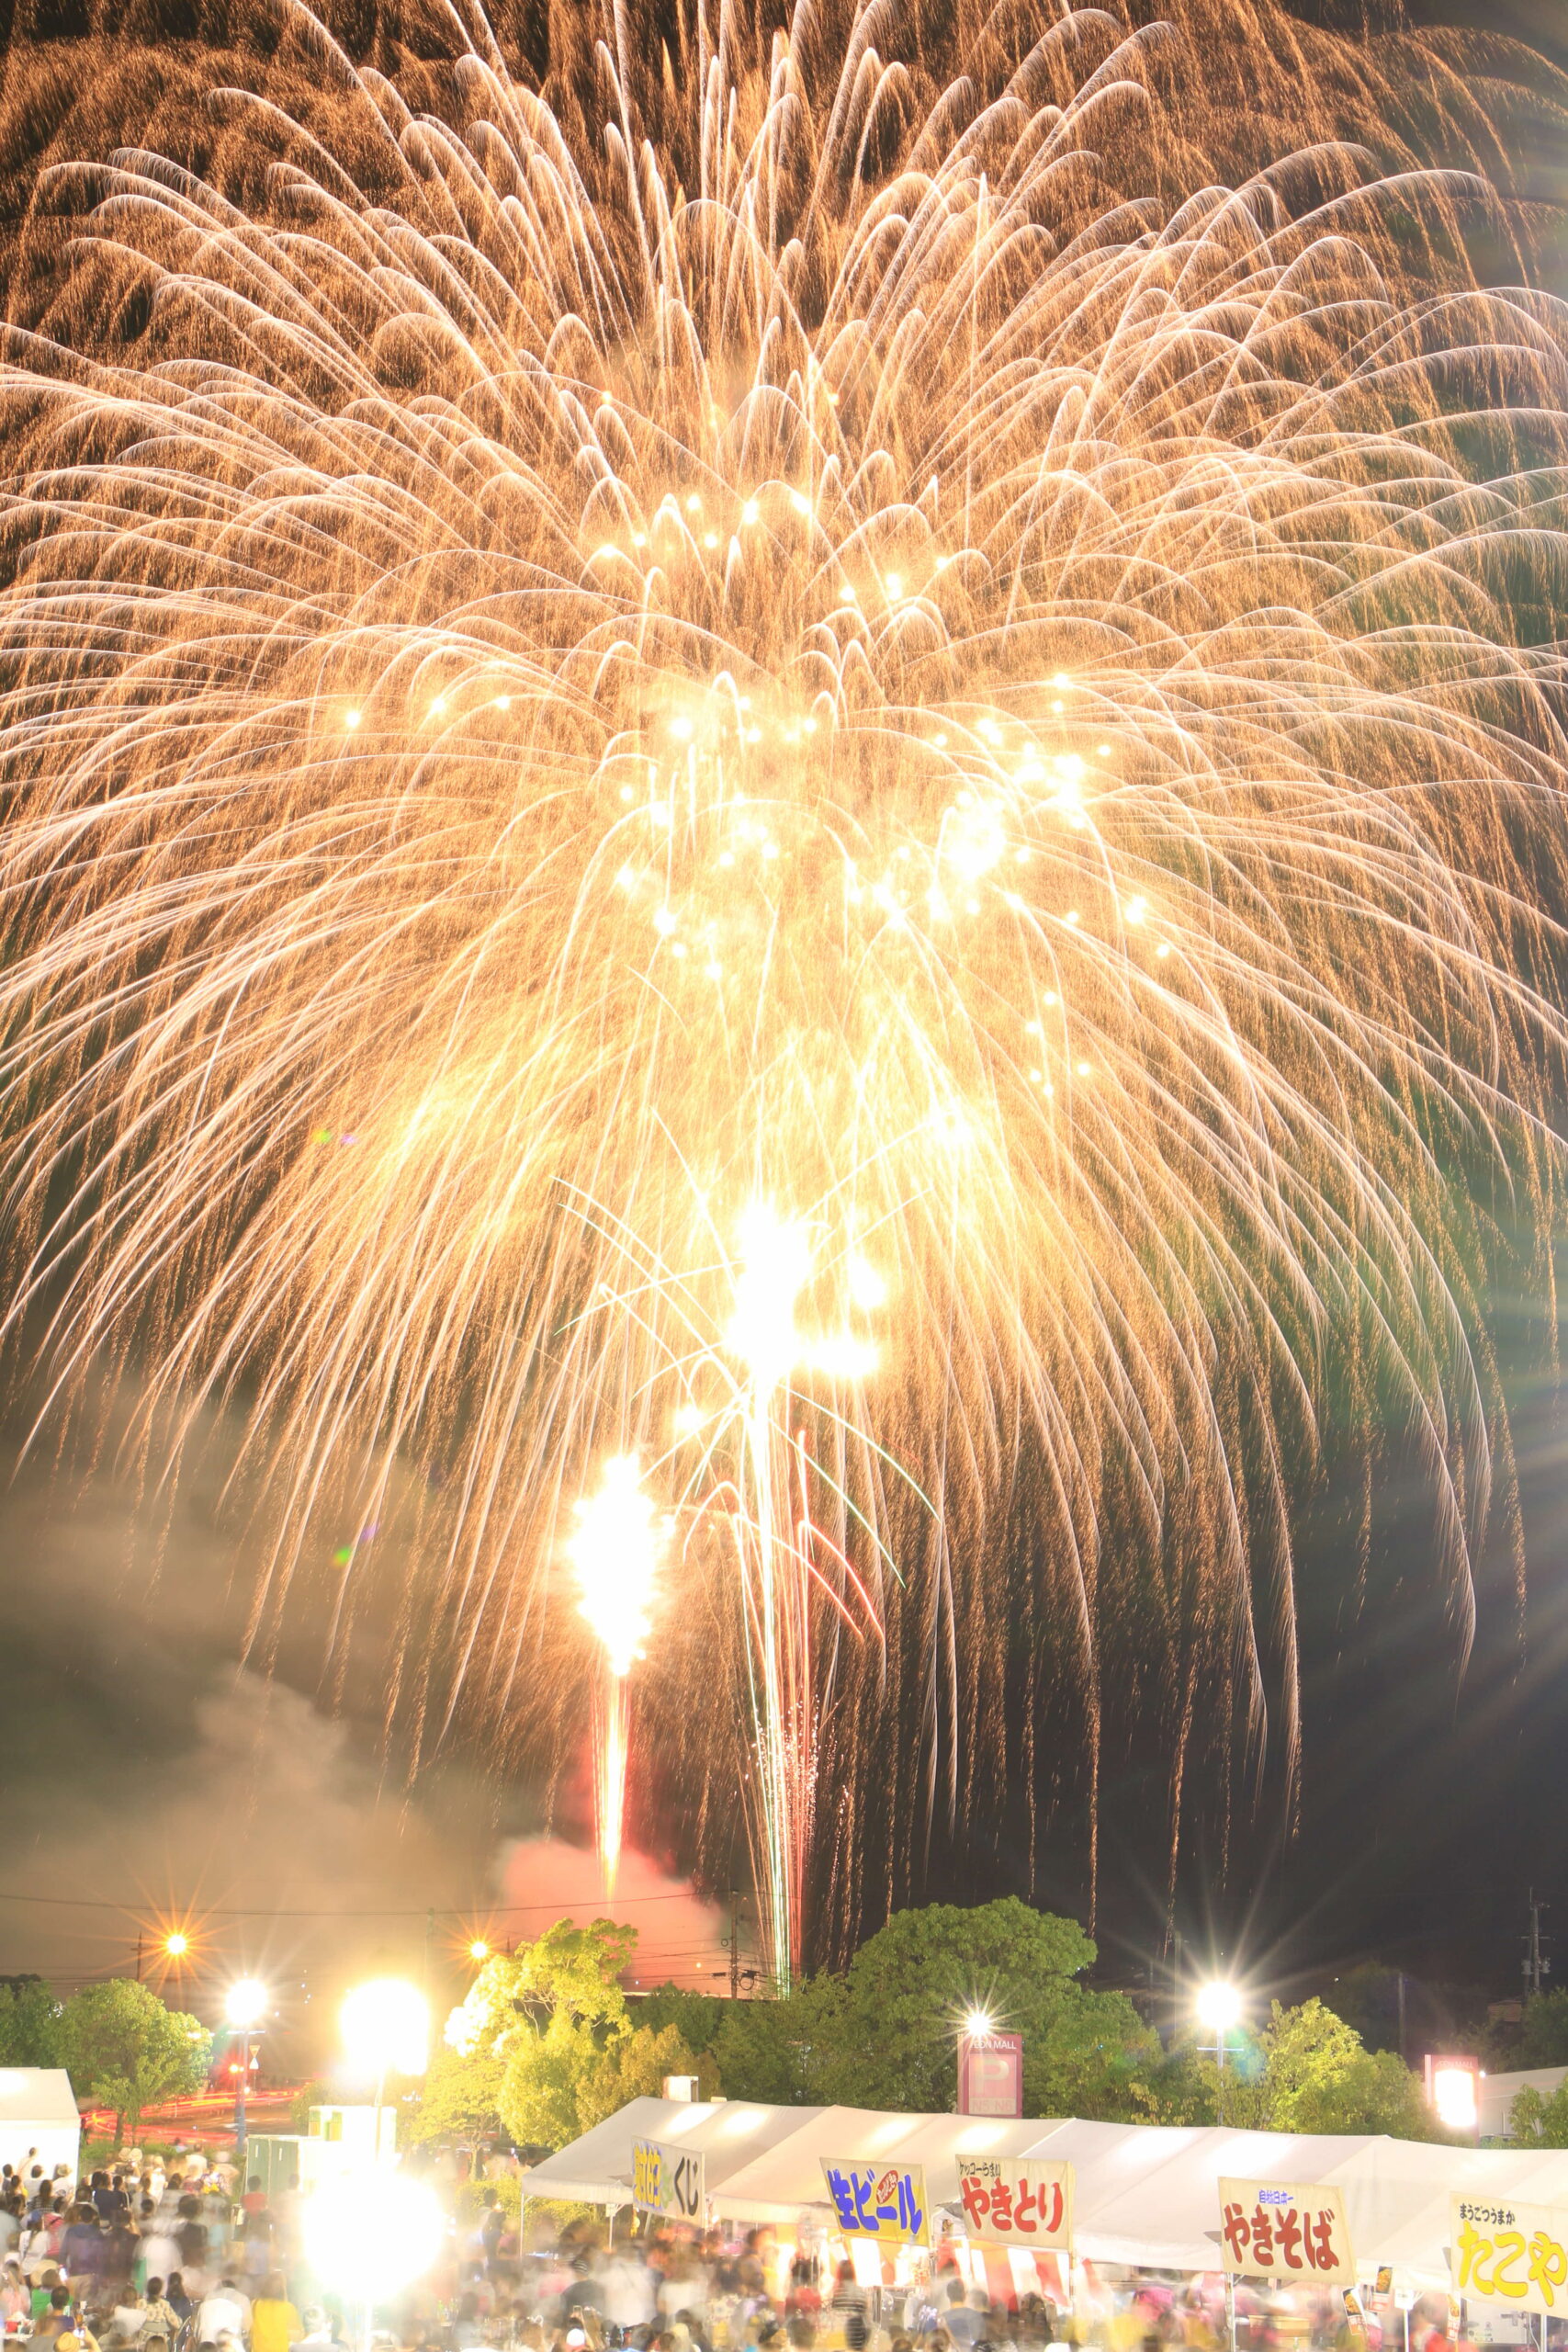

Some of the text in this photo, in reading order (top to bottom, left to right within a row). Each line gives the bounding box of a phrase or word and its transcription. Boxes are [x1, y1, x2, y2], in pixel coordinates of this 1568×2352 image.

[993, 2040, 1017, 2050] MALL
[976, 2059, 1010, 2094] P
[674, 2155, 699, 2217] くじ
[827, 2168, 922, 2234] 生ビール
[961, 2177, 1064, 2233] やきとり
[1460, 2203, 1516, 2225] まうごつうまか
[1224, 2202, 1339, 2270] やきそば
